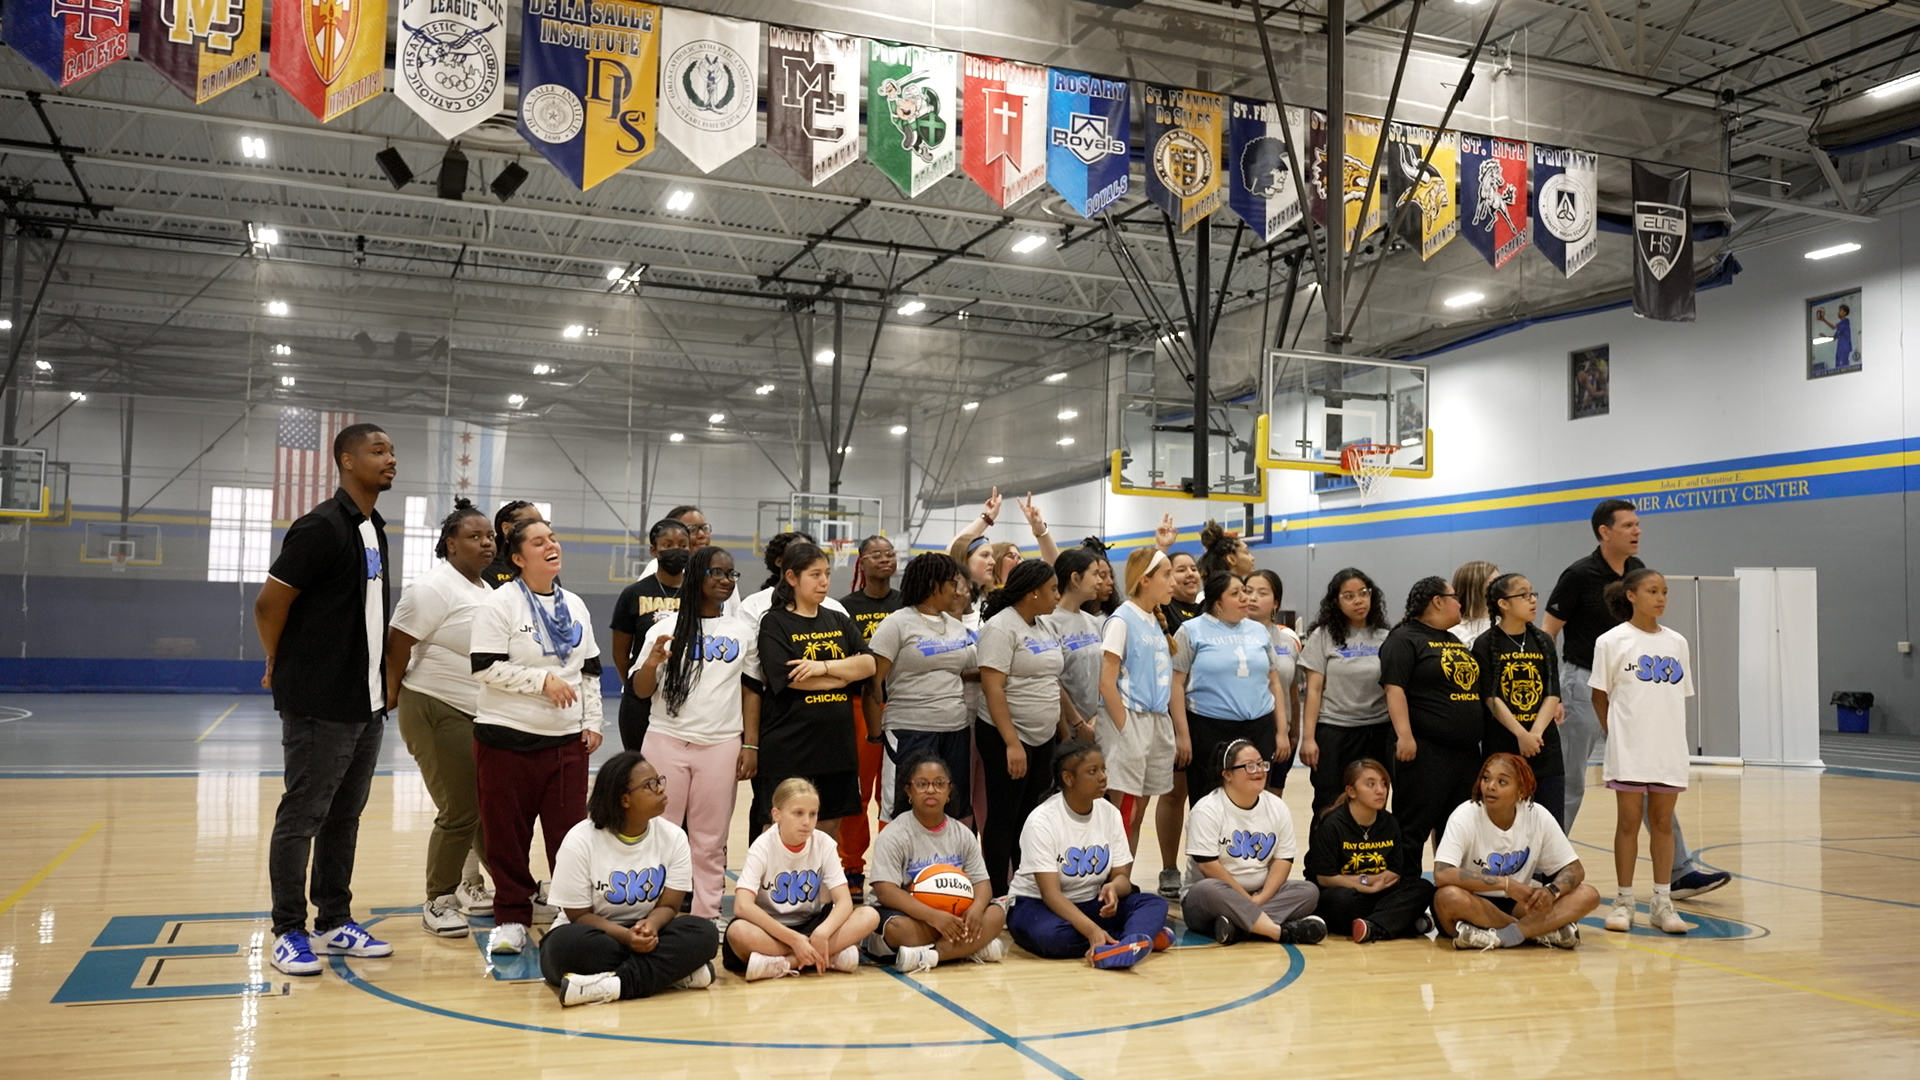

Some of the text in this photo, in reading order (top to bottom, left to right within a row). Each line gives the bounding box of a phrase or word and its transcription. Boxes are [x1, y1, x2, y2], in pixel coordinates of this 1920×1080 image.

[430, 0, 478, 21] LEAGUE
[529, 0, 557, 15] DE
[559, 0, 586, 24] LA
[590, 2, 655, 33] SALLE
[412, 23, 457, 51] ATLETIC
[540, 19, 640, 57] INSTITUTE
[769, 26, 812, 53] MOUNT
[64, 33, 127, 81] CADETS
[200, 52, 258, 99] BRONCOS
[1054, 72, 1127, 101] ROSARY
[408, 73, 461, 110] CATHOLIC
[782, 56, 846, 142] MC
[1146, 86, 1221, 113] ST. FRANCIS
[1233, 101, 1301, 127] ST. FRANIS
[1051, 127, 1126, 155] Royals
[1389, 122, 1456, 151] ST. LAURECE
[1461, 134, 1528, 161] ST. RITA
[1535, 146, 1597, 172] TRINITY
[1085, 175, 1127, 216] ROYALS
[1267, 199, 1302, 236] SPARTAN
[1649, 233, 1672, 255] HS
[1660, 480, 1676, 490] John
[1686, 478, 1700, 487] and
[1700, 475, 1734, 486] Christine
[1665, 487, 1739, 509] ACTIVITY
[1742, 480, 1811, 502] CENTER
[497, 572, 514, 581] RA
[855, 612, 873, 621] RAY
[791, 630, 843, 643] RAY GRAHAM
[1154, 650, 1169, 686] 2
[1234, 645, 1250, 678] 1
[1500, 653, 1511, 661] AY
[1624, 654, 1684, 685] Jr SKY
[805, 693, 848, 704] CHICAGO
[1450, 693, 1480, 701] CHICA
[1219, 829, 1277, 862] Jr SKY
[1343, 840, 1394, 850] RAY GRAHAM
[1061, 843, 1111, 877] SKY
[1472, 846, 1531, 877] Jr SKY
[595, 864, 667, 906] Jr SKY
[770, 866, 823, 906] SKY
[934, 878, 973, 894] Wilson
